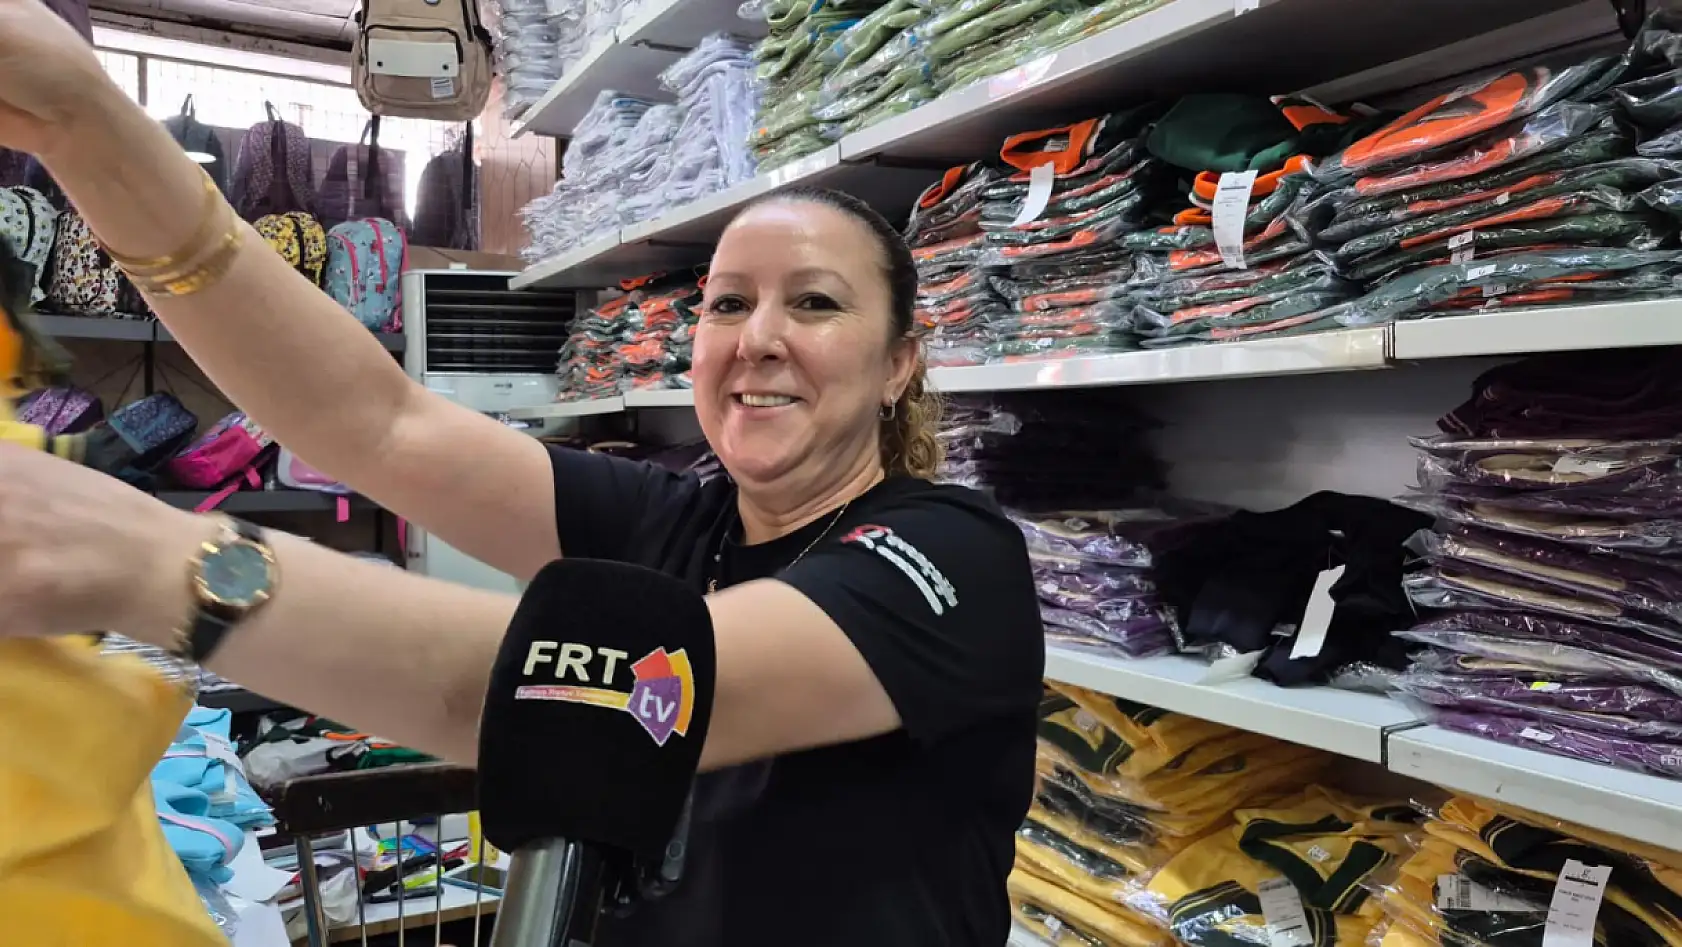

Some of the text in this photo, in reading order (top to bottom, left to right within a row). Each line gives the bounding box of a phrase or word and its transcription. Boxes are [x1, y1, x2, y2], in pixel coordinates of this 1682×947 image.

[522, 640, 628, 685] FRT
[639, 686, 677, 723] tv
[1660, 754, 1682, 767] FET
